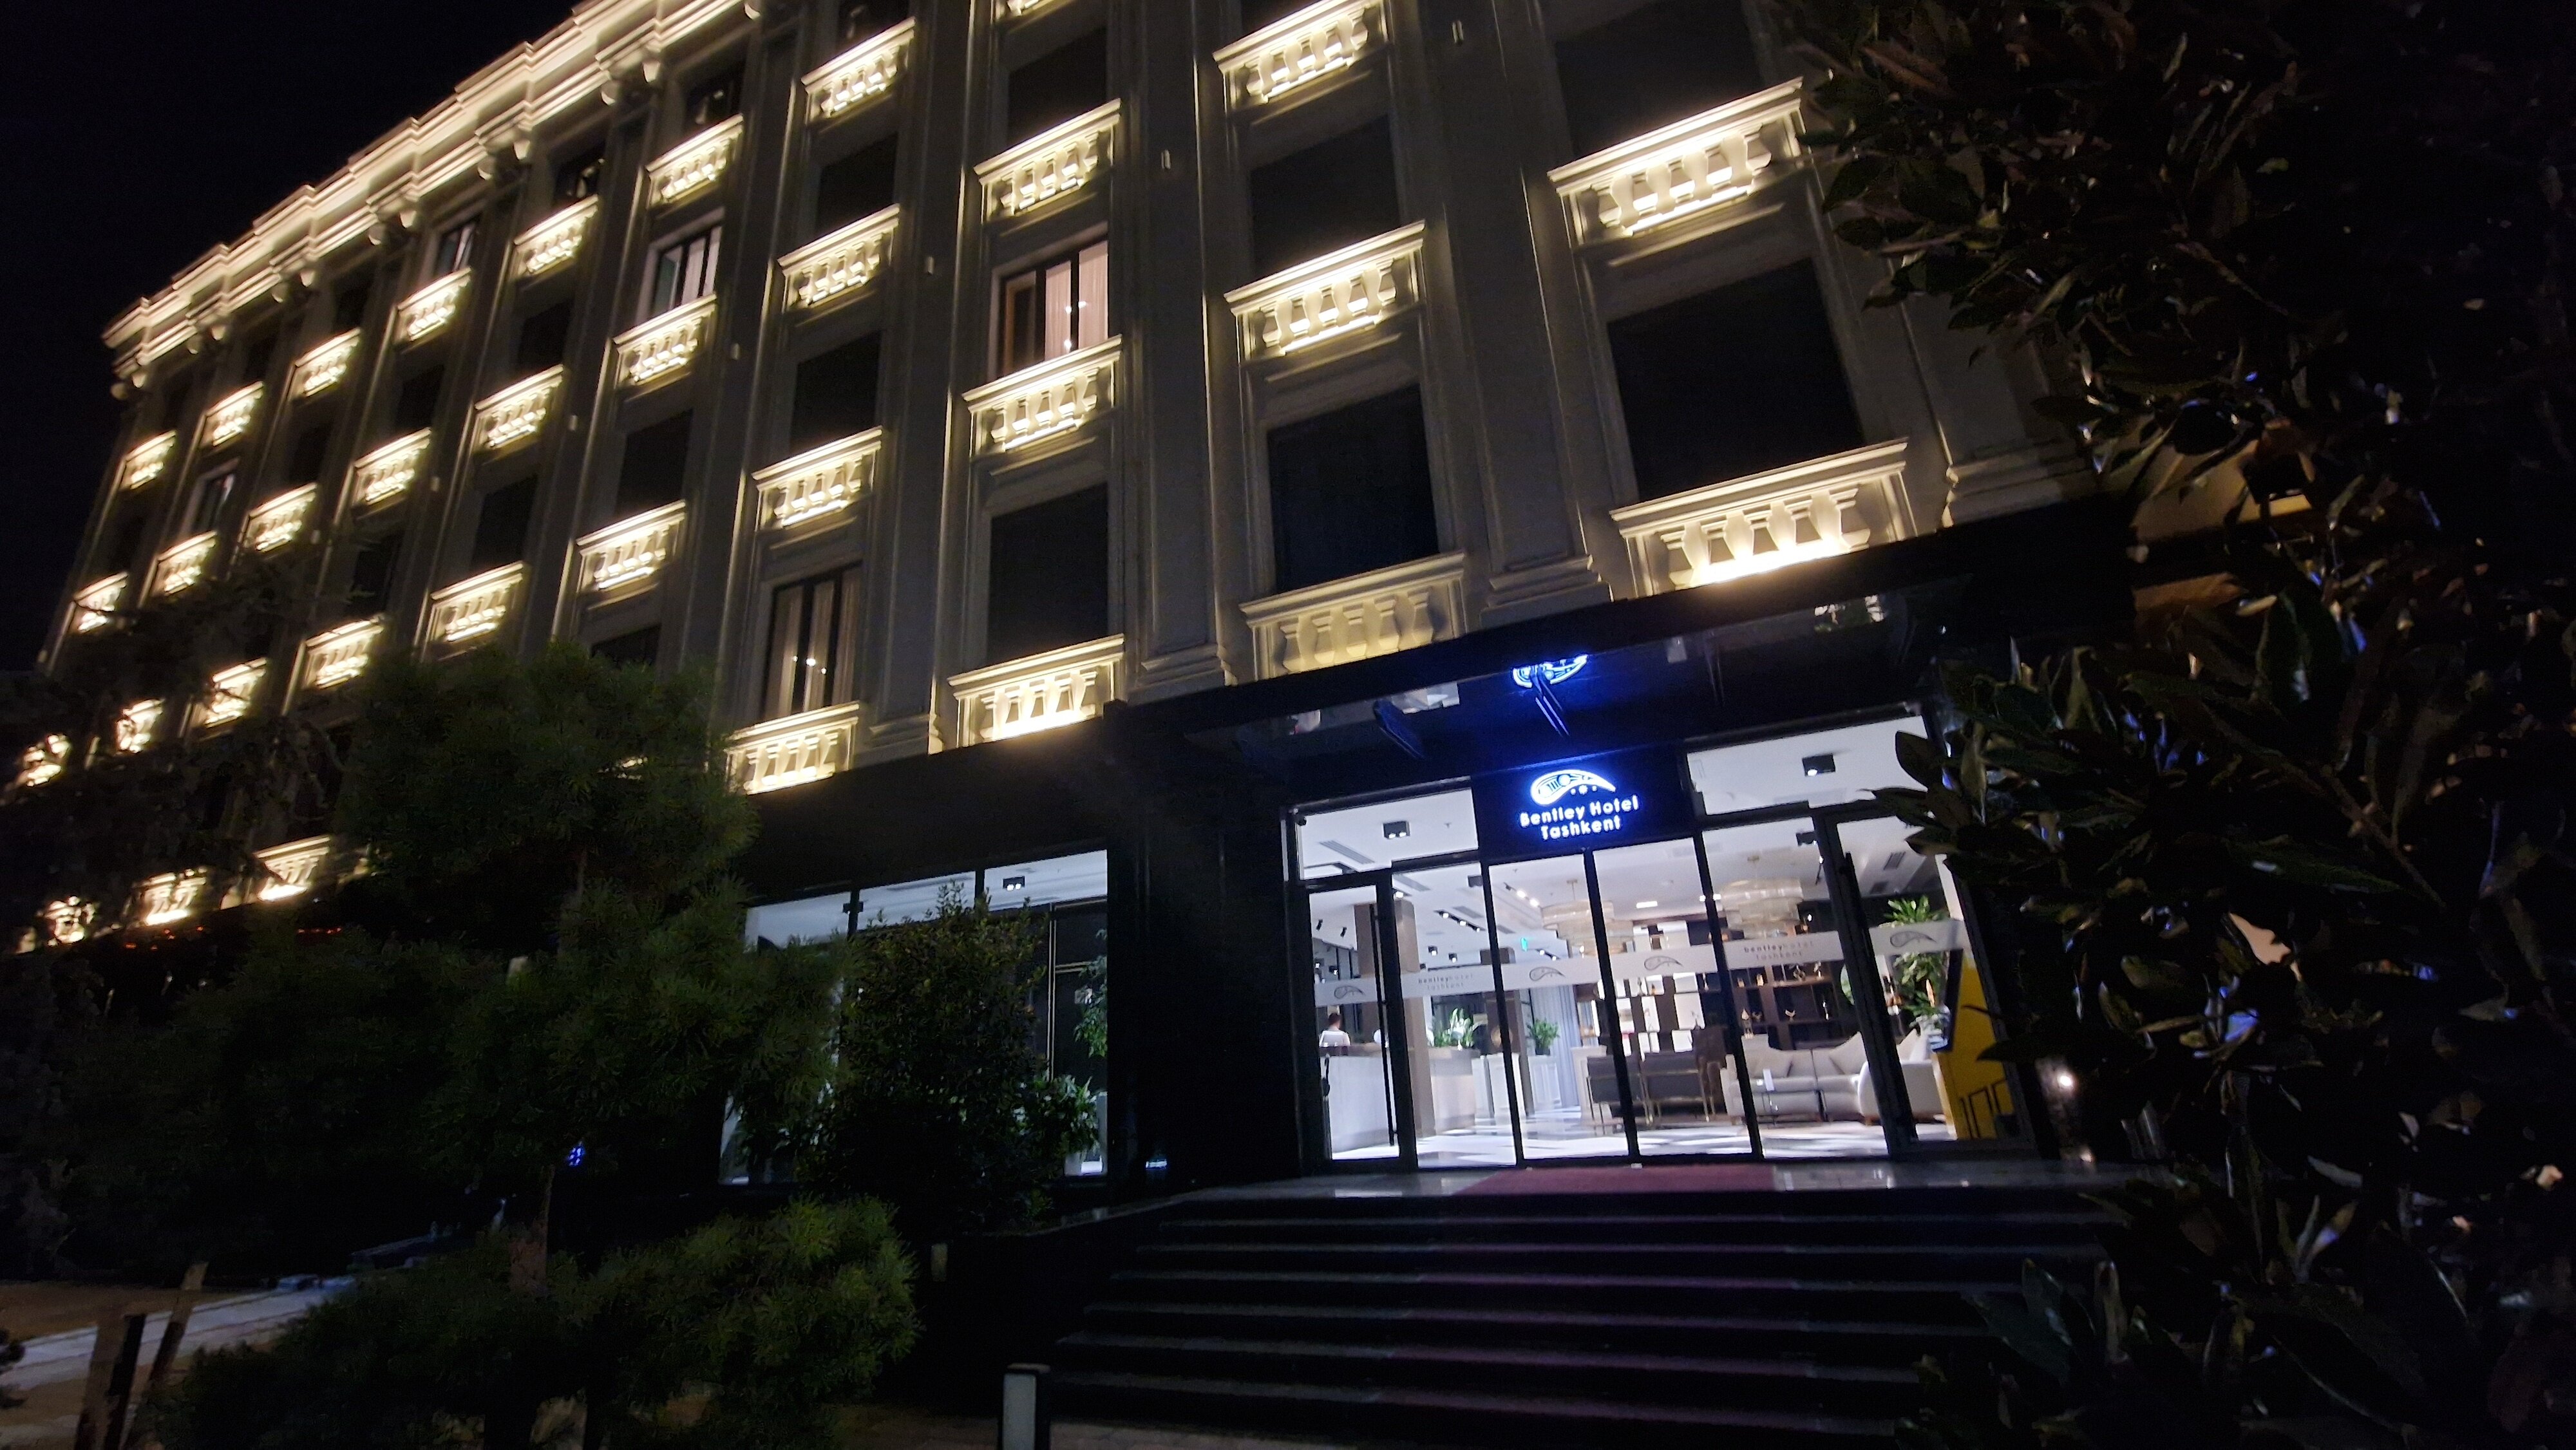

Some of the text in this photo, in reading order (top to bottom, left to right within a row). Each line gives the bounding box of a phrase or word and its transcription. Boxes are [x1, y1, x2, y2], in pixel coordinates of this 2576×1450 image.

[1520, 795, 1639, 827] Bentley Hotel
[1541, 814, 1621, 840] Tashkent
